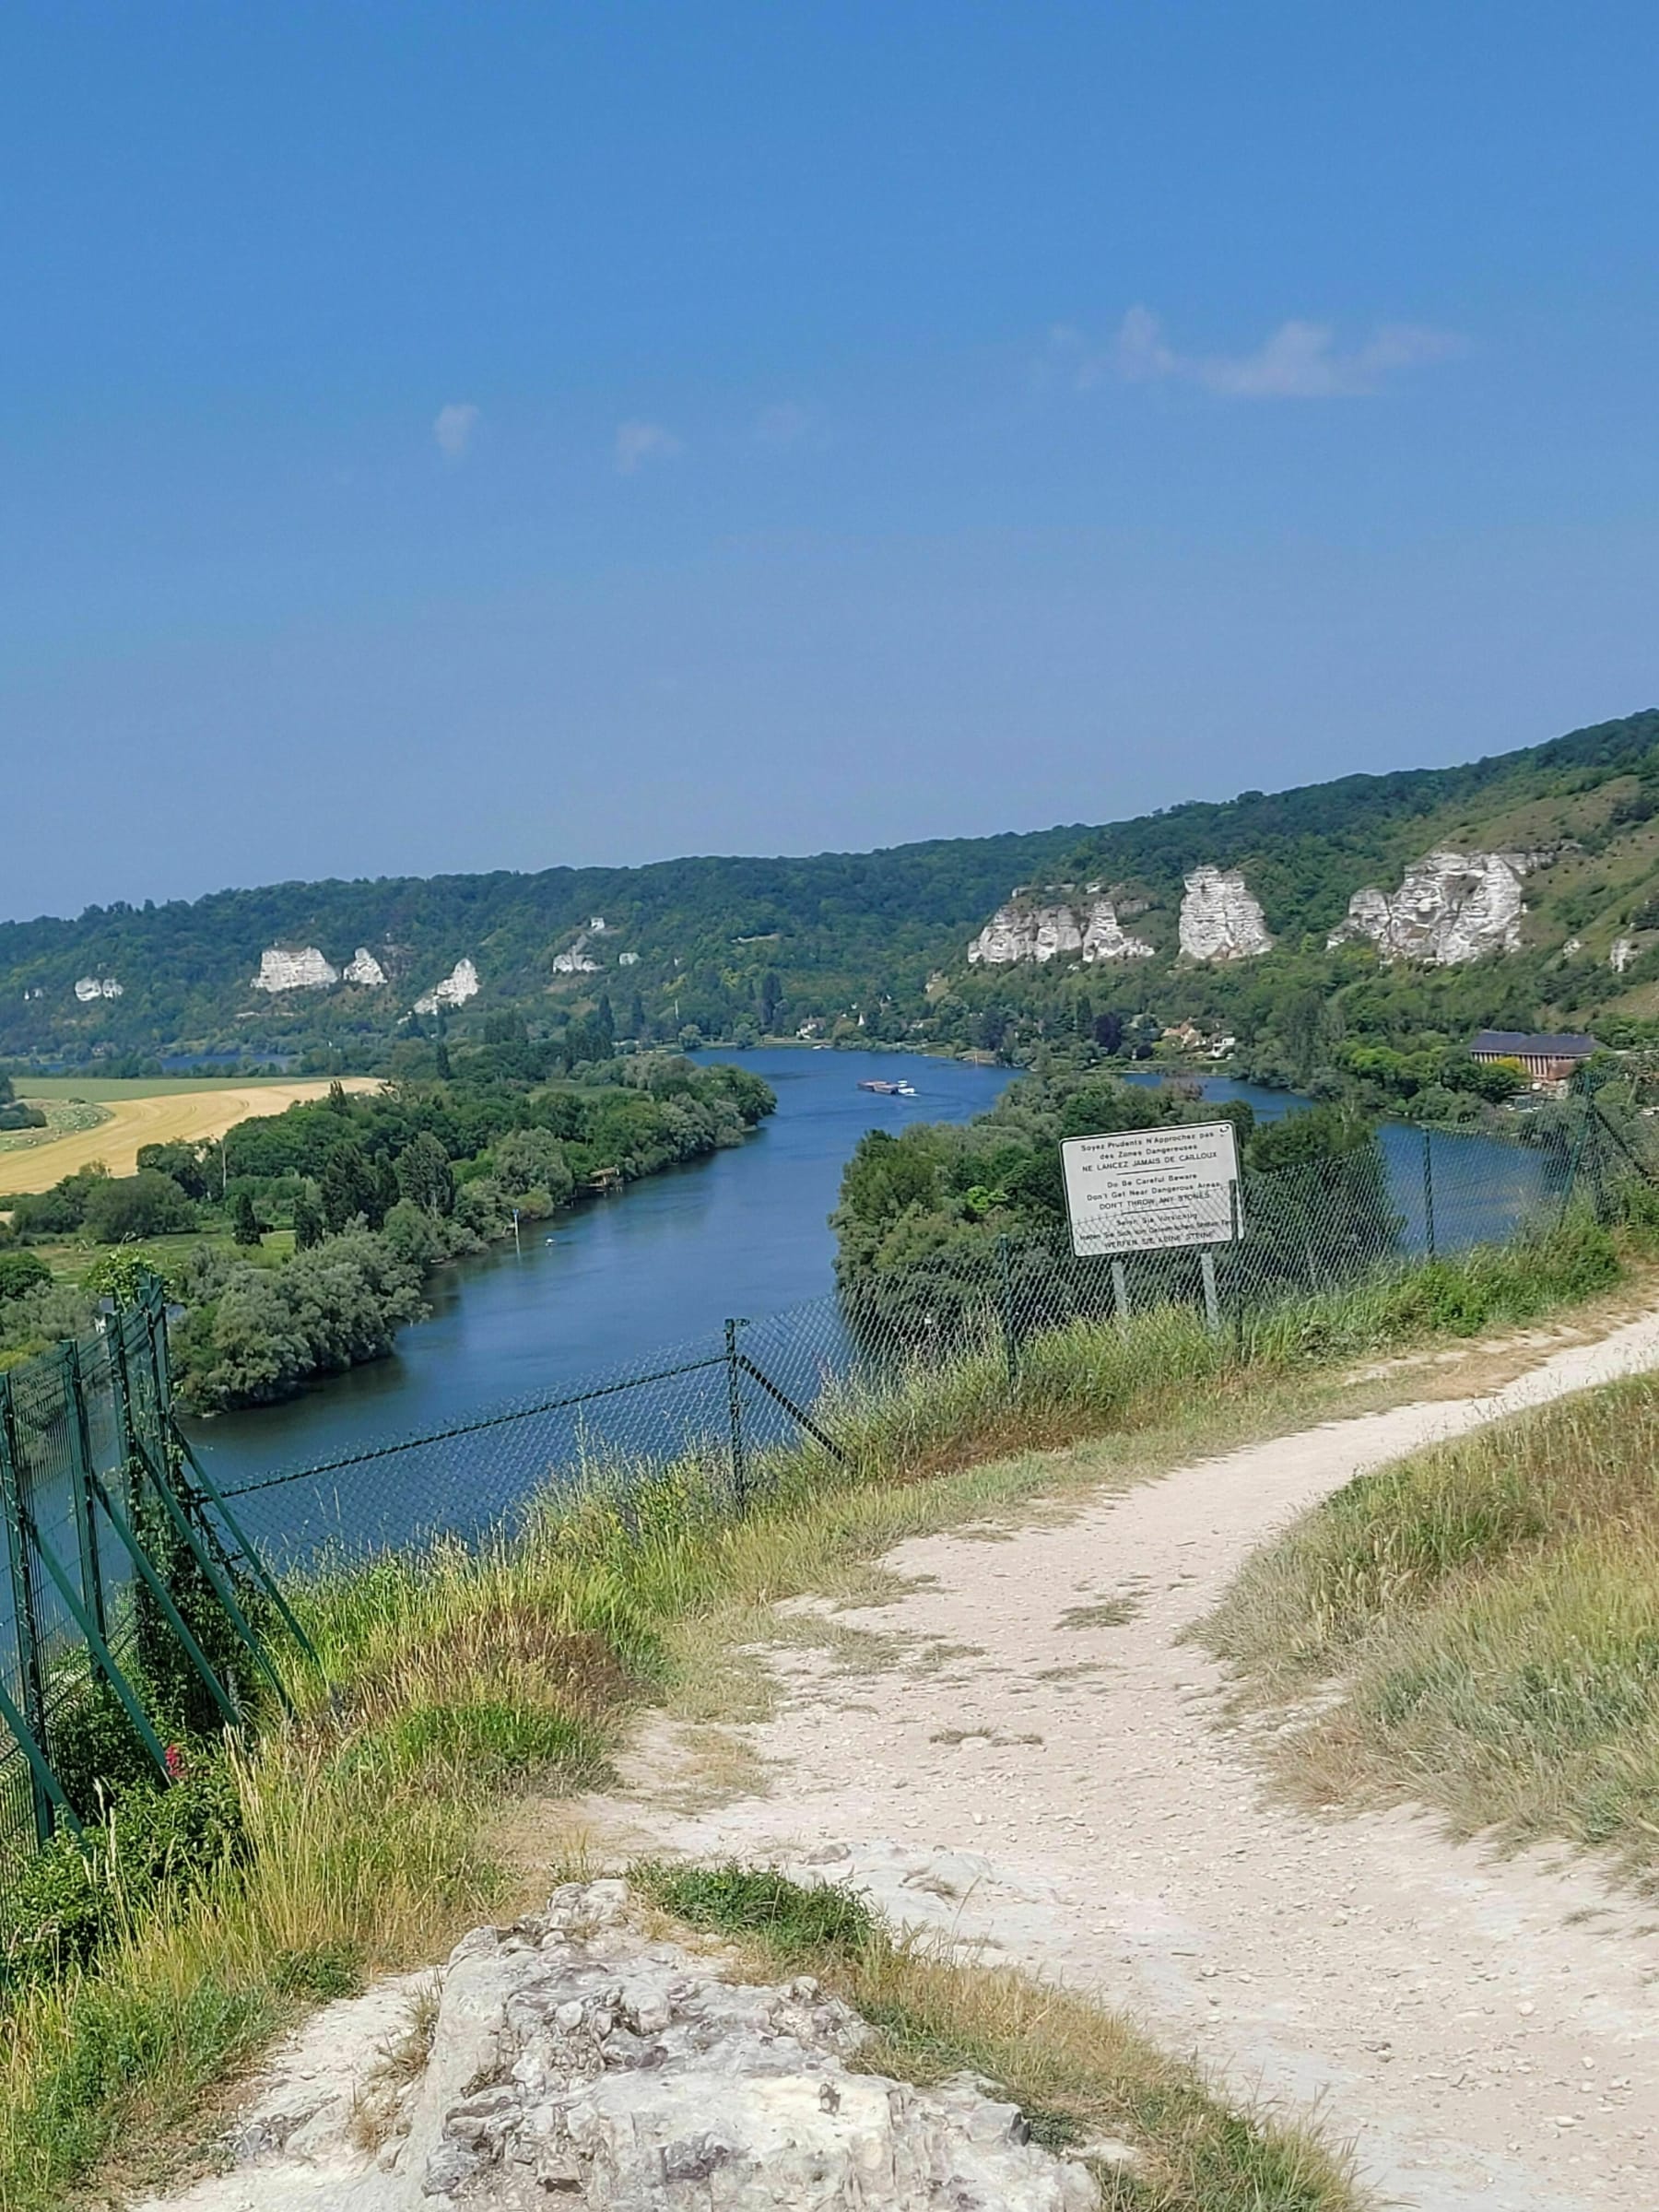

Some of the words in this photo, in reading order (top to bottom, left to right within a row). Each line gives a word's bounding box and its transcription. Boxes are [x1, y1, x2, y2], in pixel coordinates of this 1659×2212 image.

[1080, 1144, 1105, 1152] Soyez
[1107, 1139, 1142, 1148] Prudents
[1118, 1150, 1142, 1159] Zones
[1146, 1144, 1197, 1155] Dangereuses
[1097, 1161, 1128, 1171] LANCEZ
[1132, 1158, 1161, 1167] JAMAIS
[1179, 1151, 1217, 1161] CAILLOUX
[1135, 1175, 1165, 1185] Careful
[1151, 1184, 1194, 1194] Dangerous
[1099, 1201, 1123, 1210] DON'T
[1126, 1198, 1155, 1206] THROW
[1178, 1192, 1210, 1201] STONES
